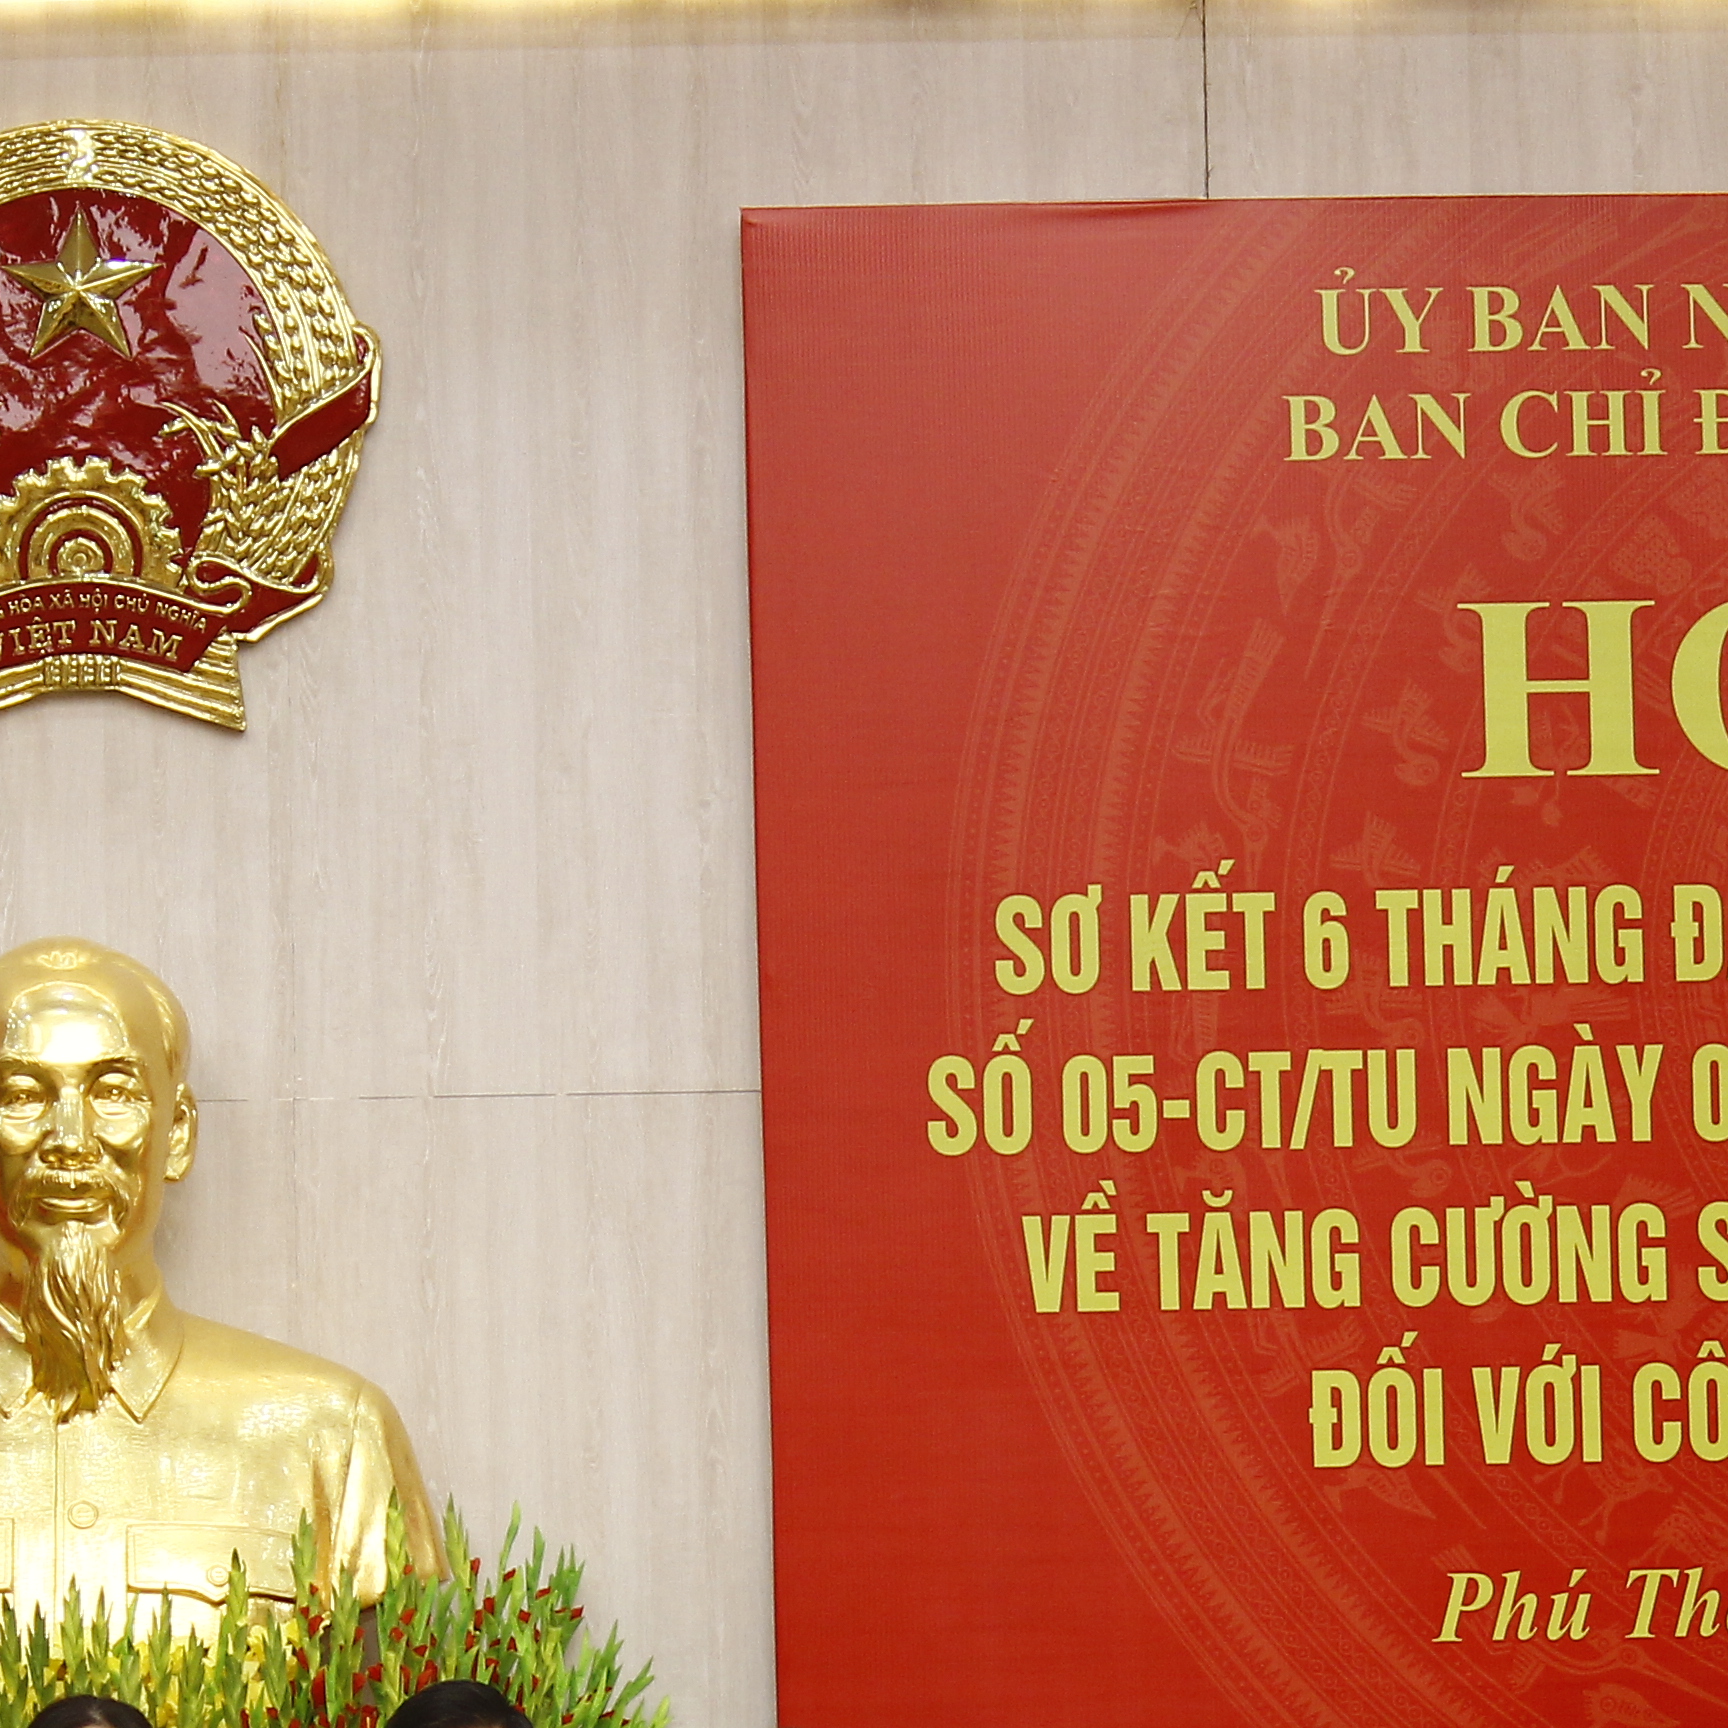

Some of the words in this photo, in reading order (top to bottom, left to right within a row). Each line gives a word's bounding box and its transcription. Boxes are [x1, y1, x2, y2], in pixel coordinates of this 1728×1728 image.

[1315, 267, 1443, 355] ỦY
[1467, 284, 1654, 352] BAN
[1284, 393, 1471, 461] BAN
[1500, 369, 1667, 458] CHỈ
[8, 593, 43, 616] HÒA
[79, 588, 108, 614] HỘI
[114, 593, 149, 614] CHỦ
[89, 620, 183, 661] NAM
[995, 884, 1102, 995] SƠ
[1130, 859, 1275, 991] KẾT
[1304, 891, 1349, 989] 6
[1375, 866, 1644, 987] THÁNG
[928, 1019, 1034, 1156] SỐ
[1062, 1049, 1417, 1153] 05-CT/TU
[1447, 1024, 1663, 1145] NGÀY
[1022, 1180, 1120, 1313] VỀ
[1146, 1190, 1360, 1310] TĂNG
[1391, 1181, 1667, 1307] CƯỜNG
[1309, 1331, 1444, 1467] ĐỐI
[1472, 1344, 1602, 1464] VỚI
[1432, 1569, 1591, 1642] Phú
